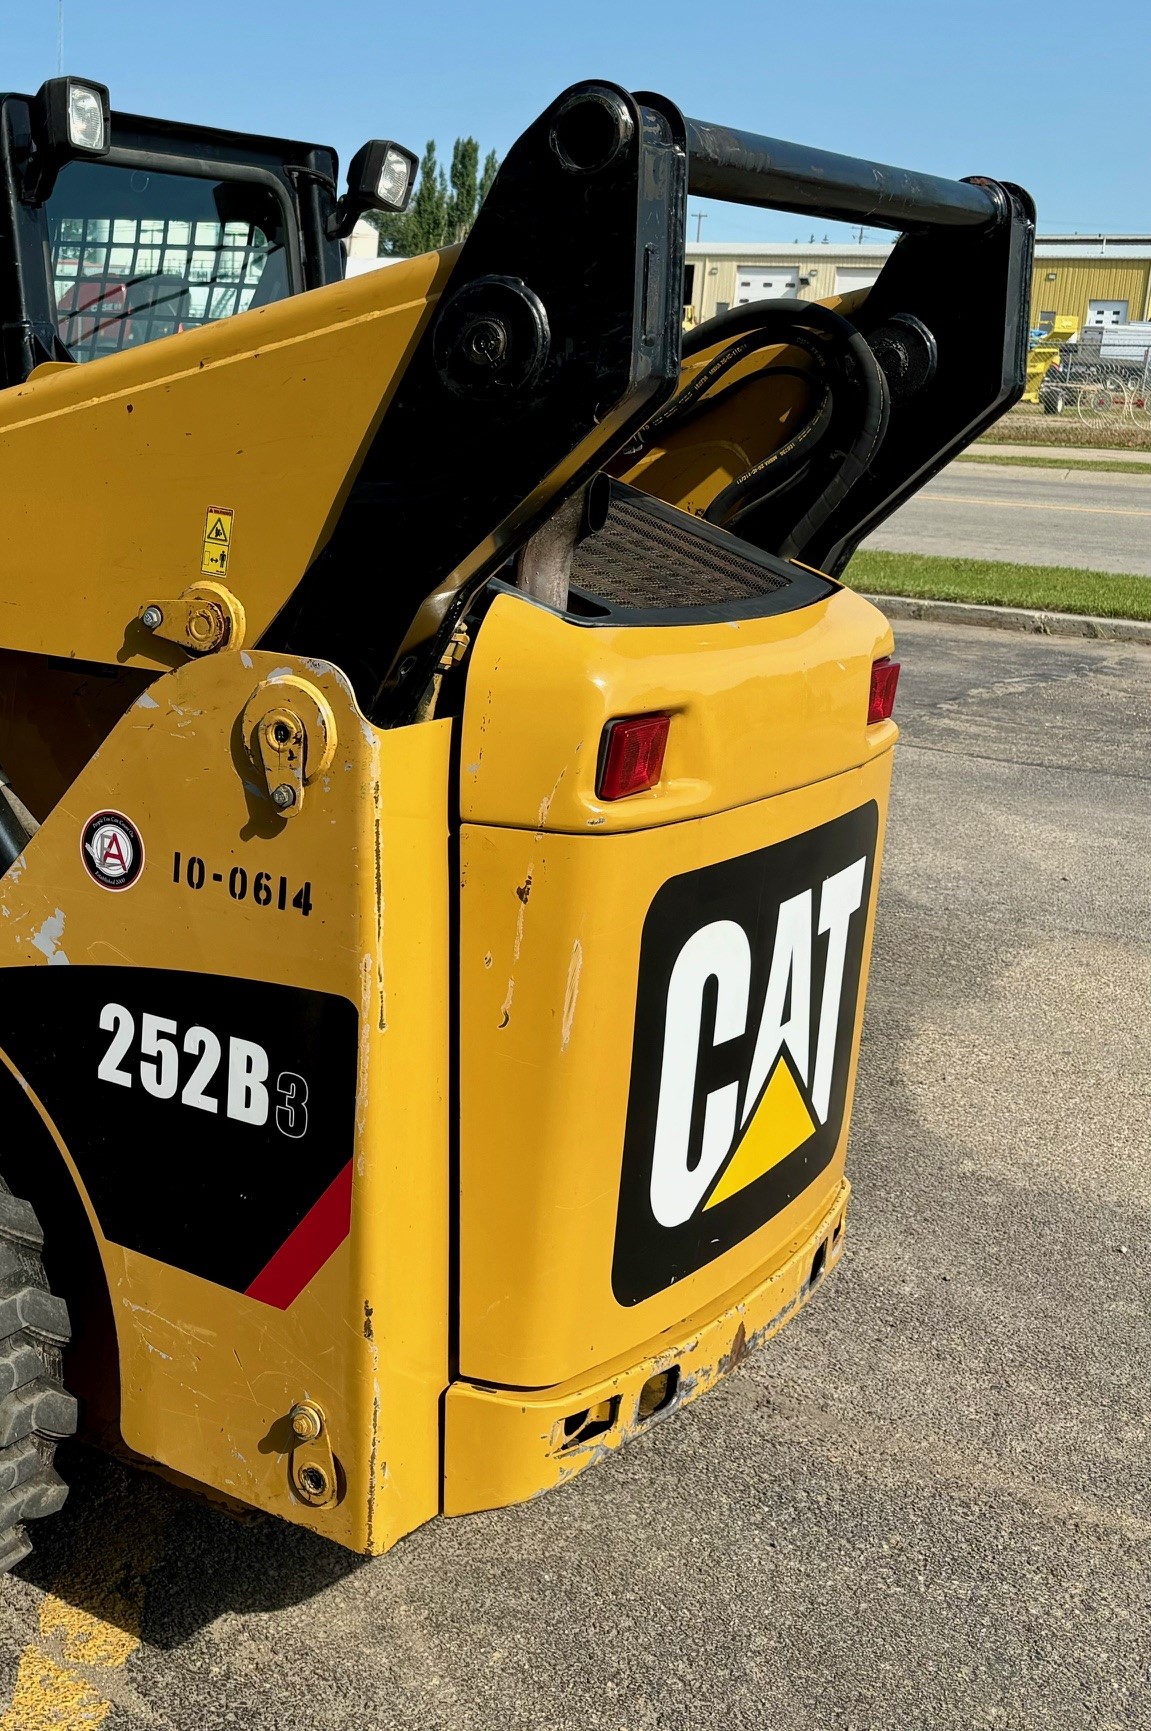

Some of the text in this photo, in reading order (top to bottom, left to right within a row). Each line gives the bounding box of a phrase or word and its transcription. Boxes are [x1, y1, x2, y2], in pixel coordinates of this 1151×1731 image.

[94, 871, 115, 885] Established
[172, 851, 313, 917] 10-0614
[649, 855, 867, 1228] CAT
